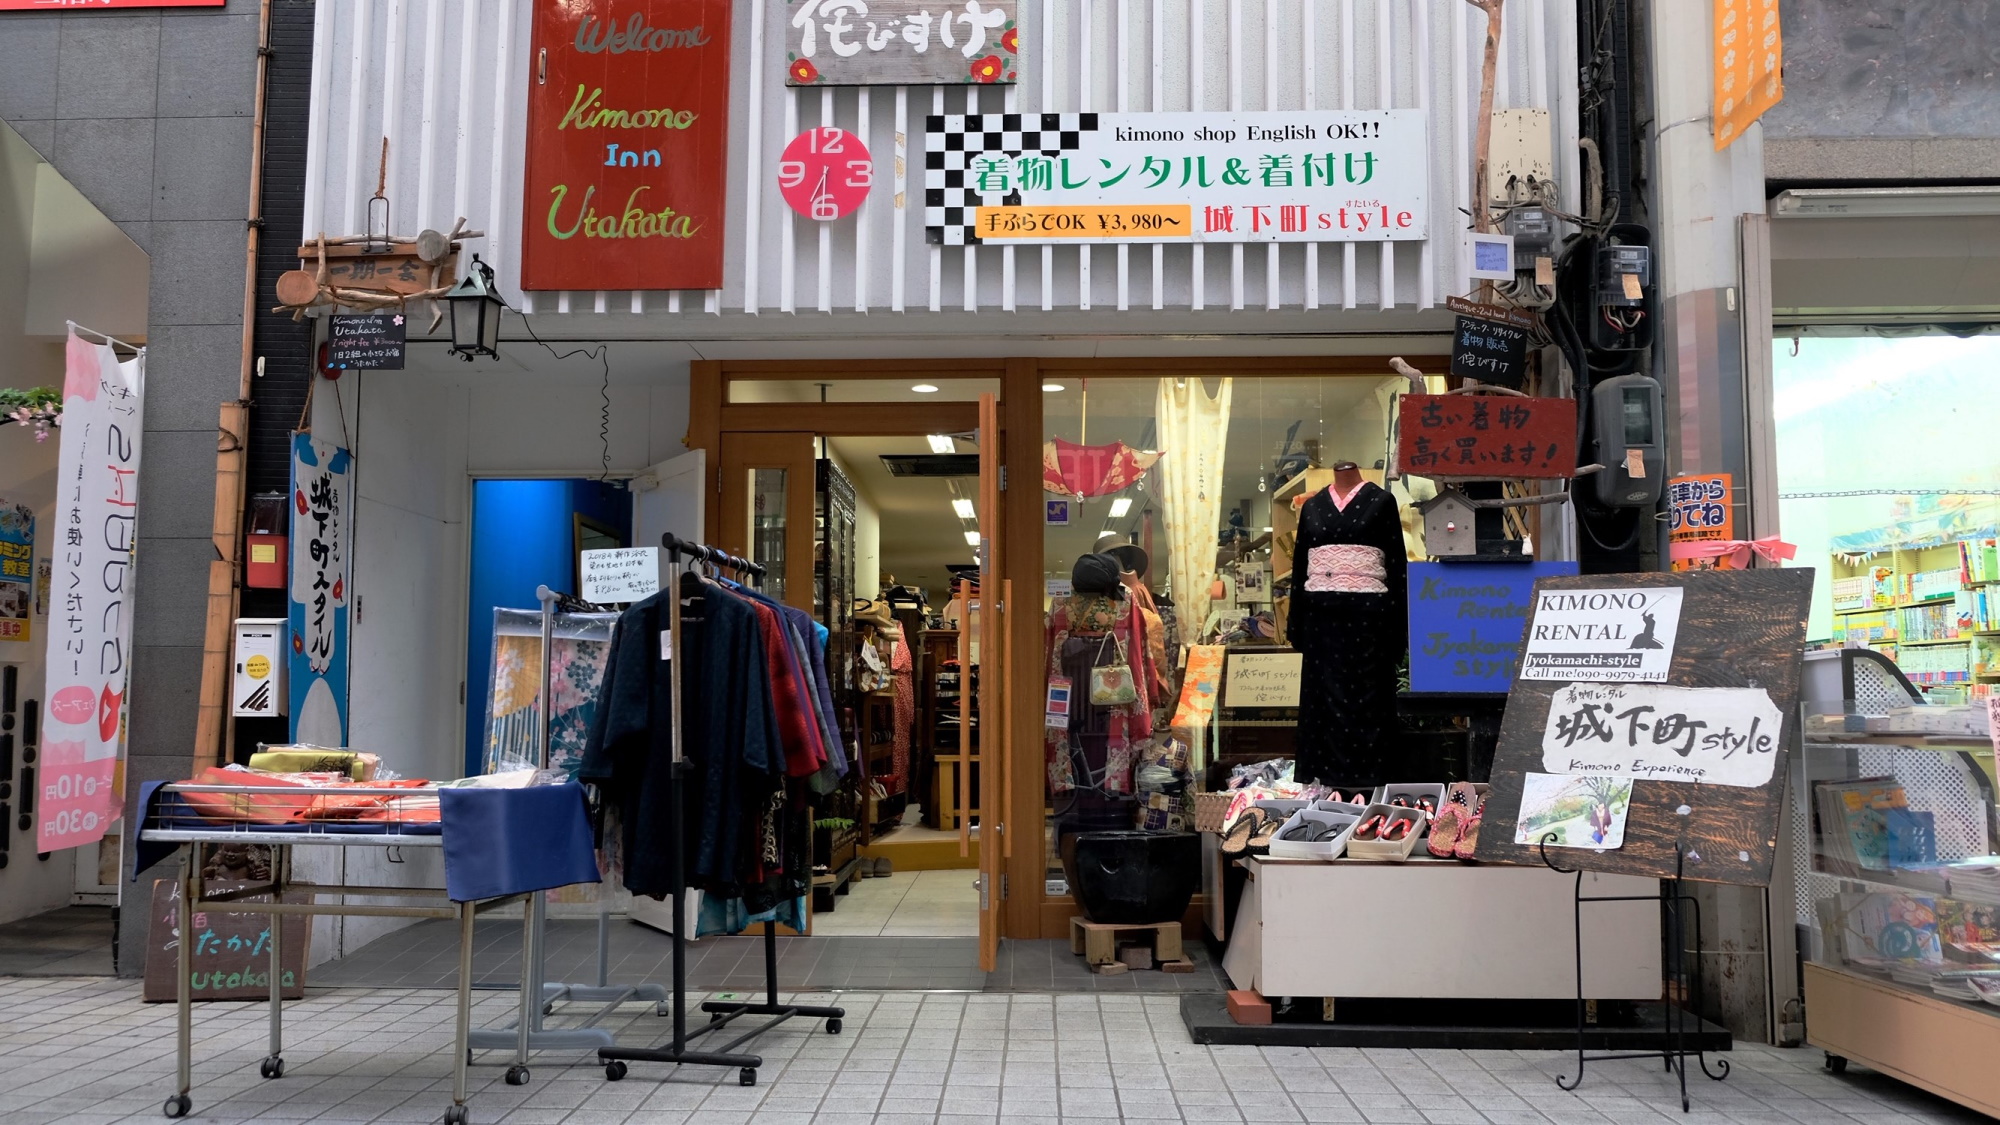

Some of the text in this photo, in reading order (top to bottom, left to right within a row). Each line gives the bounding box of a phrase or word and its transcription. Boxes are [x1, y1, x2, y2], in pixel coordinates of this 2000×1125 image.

[574, 12, 711, 54] Welcome
[558, 84, 699, 130] Kimono
[810, 127, 844, 154] 12
[1115, 121, 1380, 143] kimono shop English OK!!
[604, 143, 661, 167] Inn
[778, 160, 873, 188] 9 3
[975, 151, 1379, 191] 着物レンタル&着付け
[547, 184, 704, 240] Utakata
[811, 194, 838, 221] 6
[1345, 200, 1380, 208] すたいる
[984, 212, 1086, 231] 手ぶらでOK
[330, 259, 420, 281] 一期一会
[1421, 401, 1531, 431] 古い着物
[2, 559, 30, 577] 教室
[310, 472, 333, 659] 城下町スタイル
[1420, 576, 1512, 600] Kimono
[1457, 601, 1530, 619] Renta
[1540, 592, 1647, 611] KIMONO
[0, 621, 21, 636] 集中
[1533, 624, 1627, 640] RENTAL
[1526, 654, 1640, 668] Jyokamachi-style
[1525, 668, 1549, 678] Call
[1569, 759, 1706, 777] Kimono Experience
[191, 965, 295, 990] Utakaa
